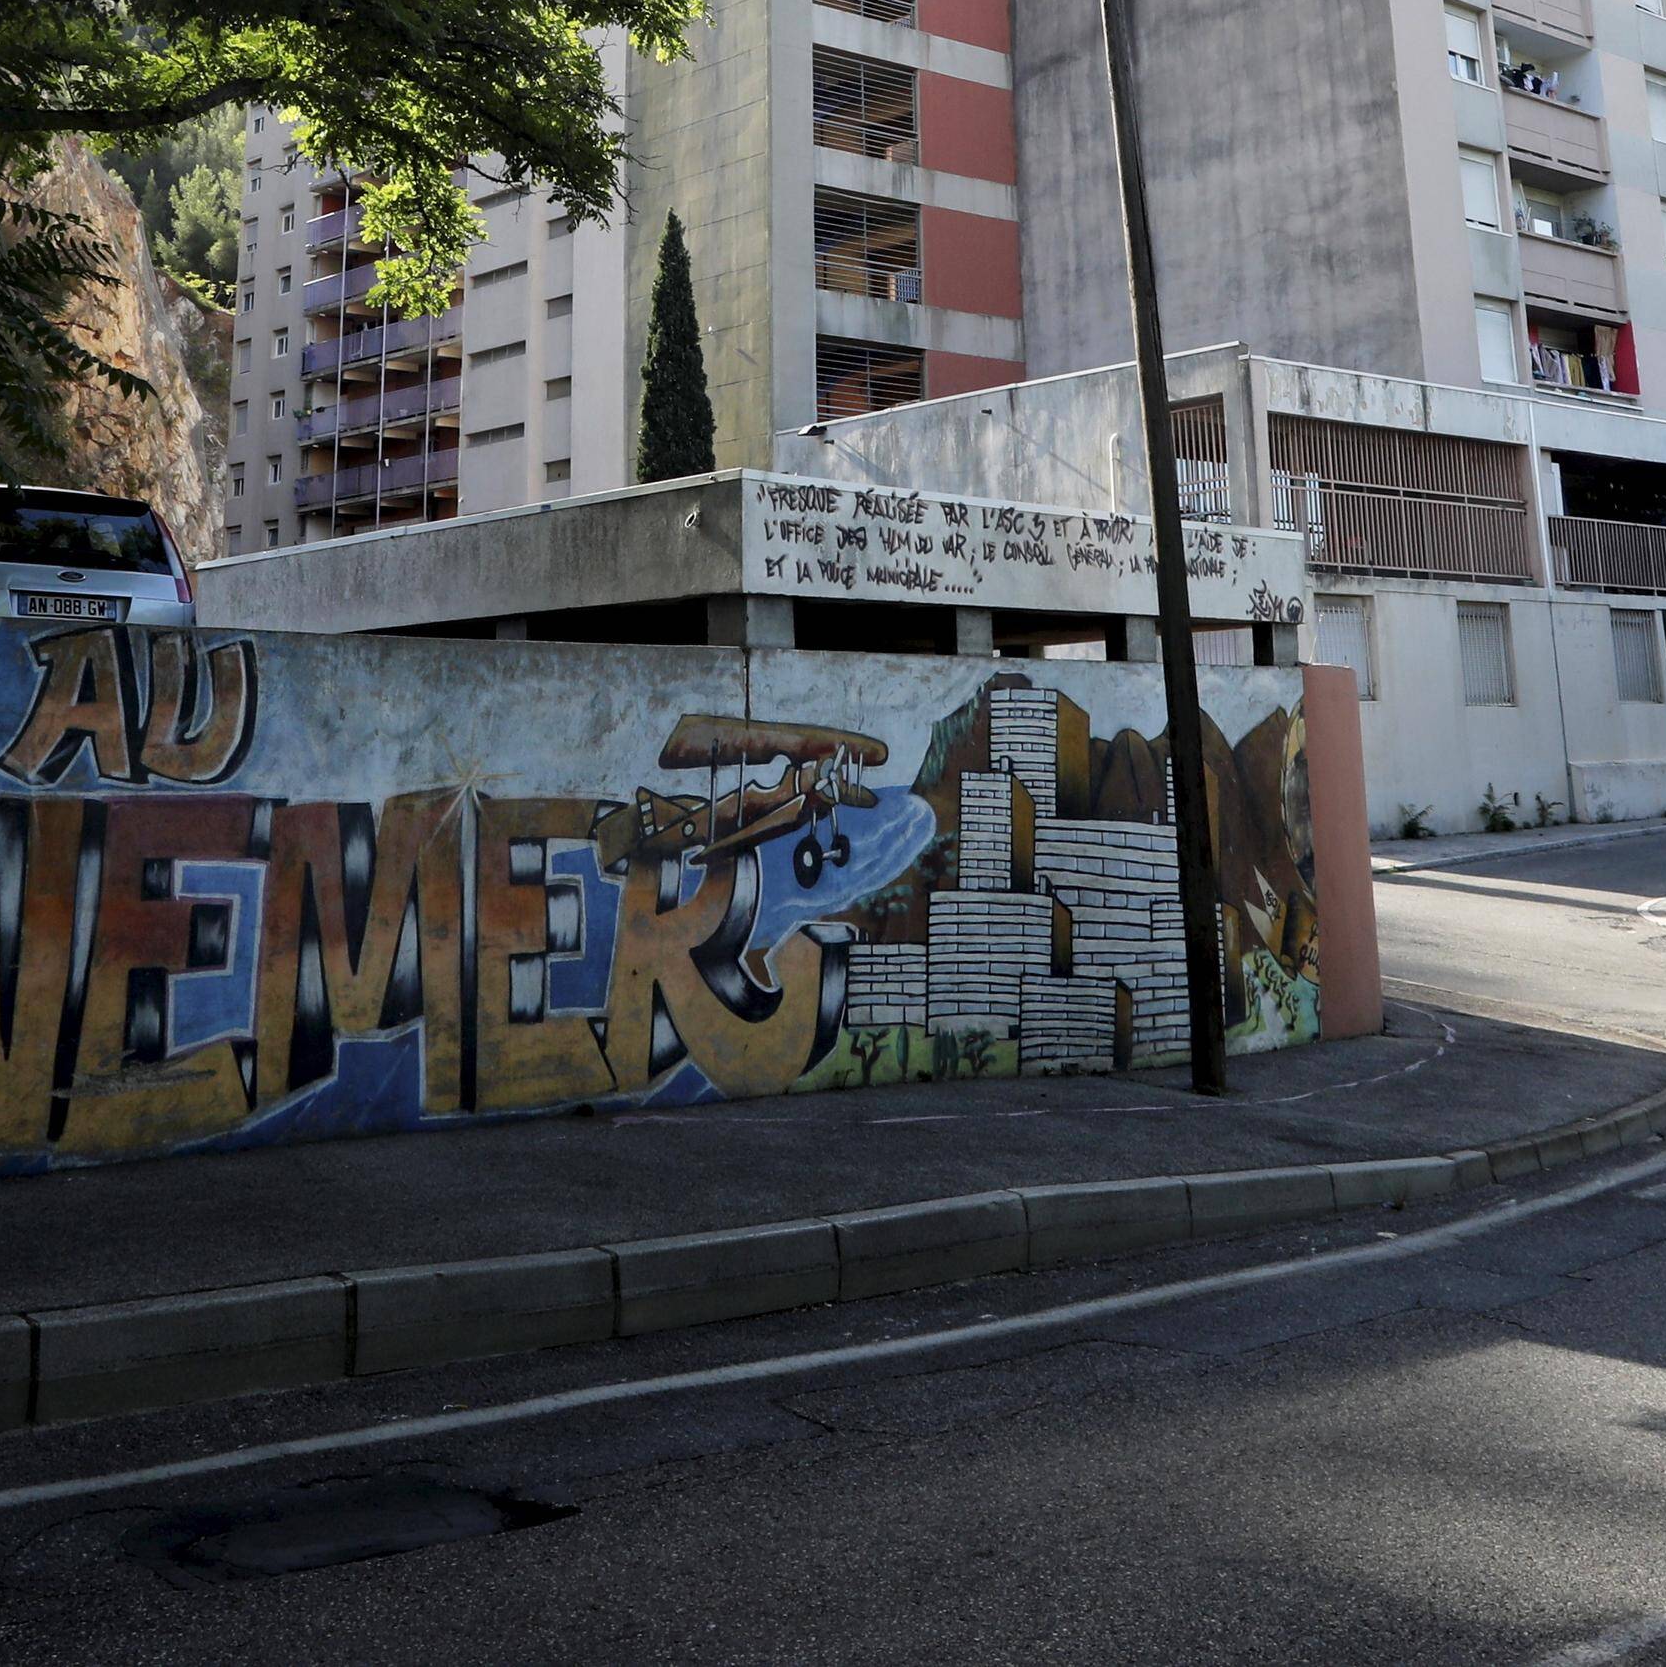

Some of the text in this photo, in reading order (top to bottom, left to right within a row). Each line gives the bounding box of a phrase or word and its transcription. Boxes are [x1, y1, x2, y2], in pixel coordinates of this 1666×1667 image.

[939, 501, 970, 528] PAR
[1053, 516, 1074, 539] ET
[764, 553, 788, 579] ET
[795, 558, 814, 585] LA
[914, 533, 934, 555] DU
[983, 541, 996, 563] LE
[1129, 554, 1142, 574] LA
